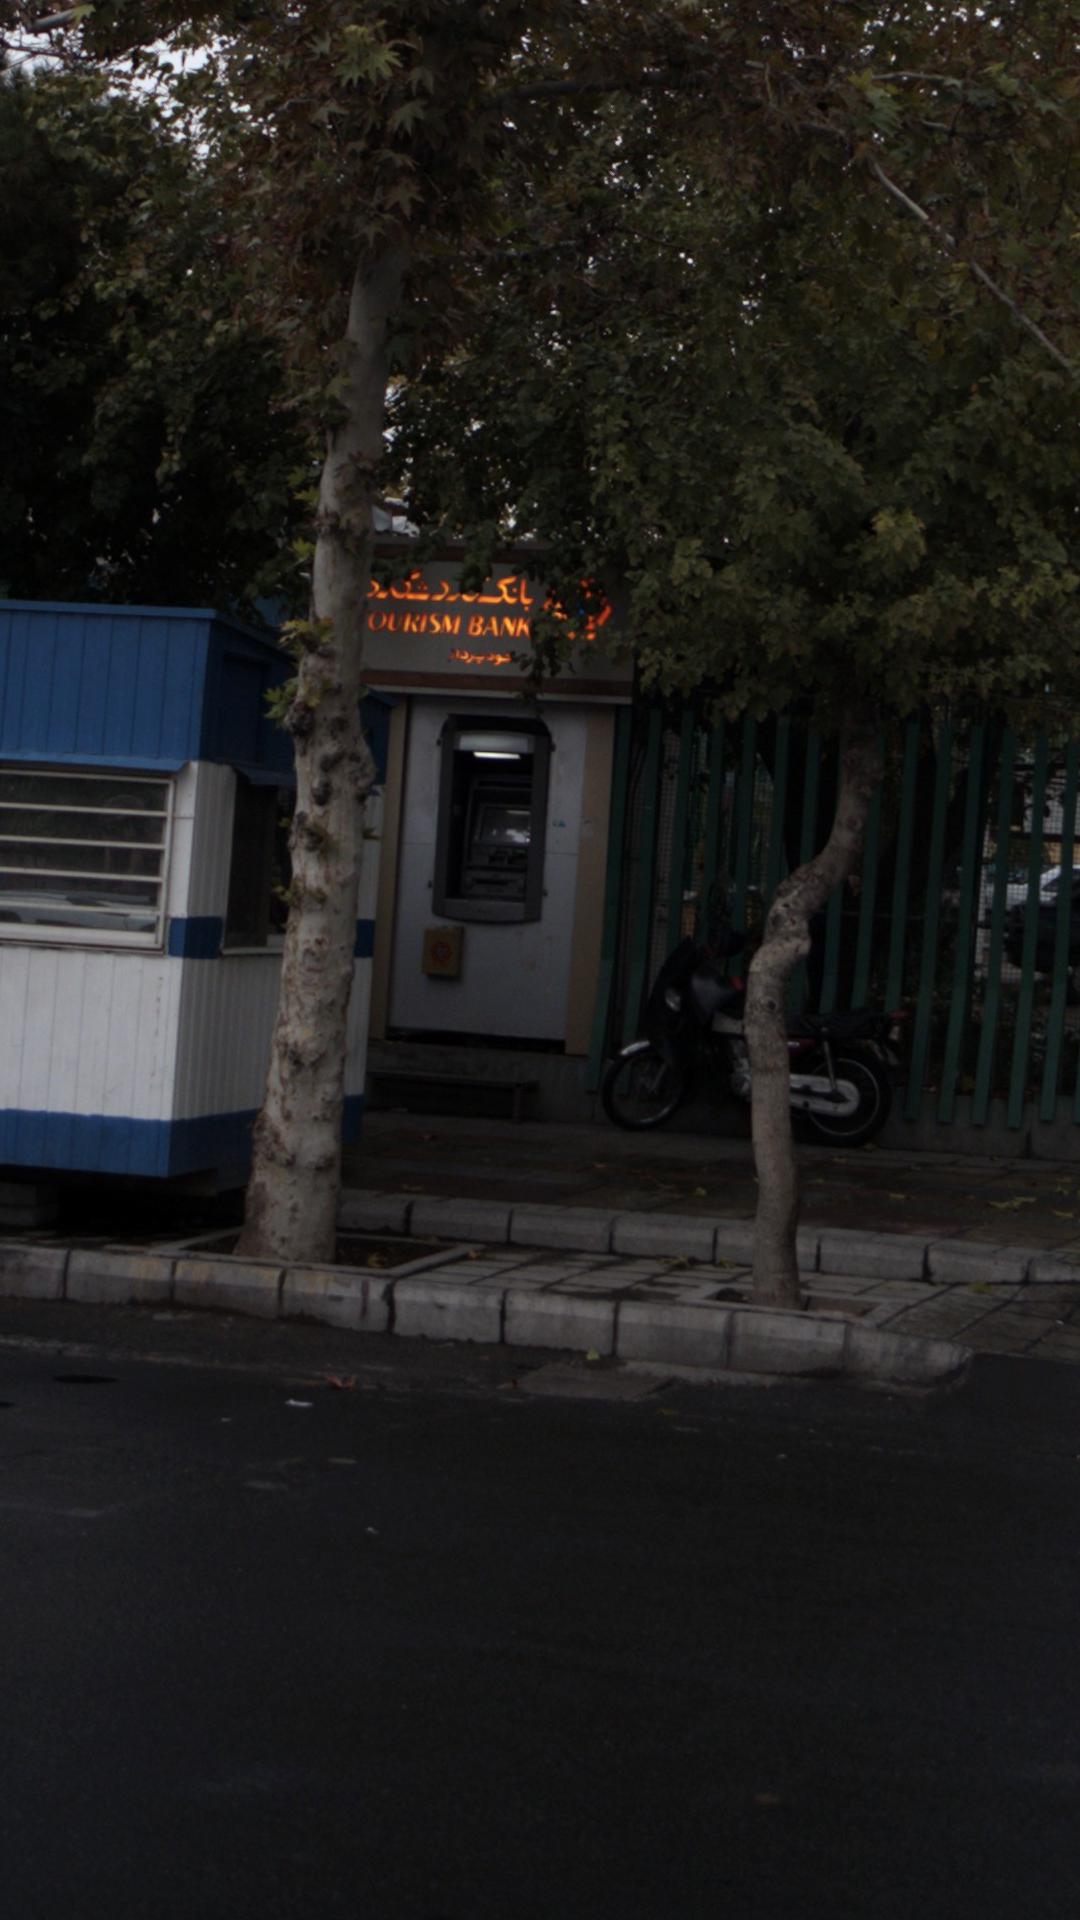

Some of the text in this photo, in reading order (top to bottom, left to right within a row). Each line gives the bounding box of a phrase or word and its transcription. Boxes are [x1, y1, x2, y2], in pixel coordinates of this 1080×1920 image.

[477, 576, 534, 612] بانک
[367, 609, 532, 638] OURISM BANK
